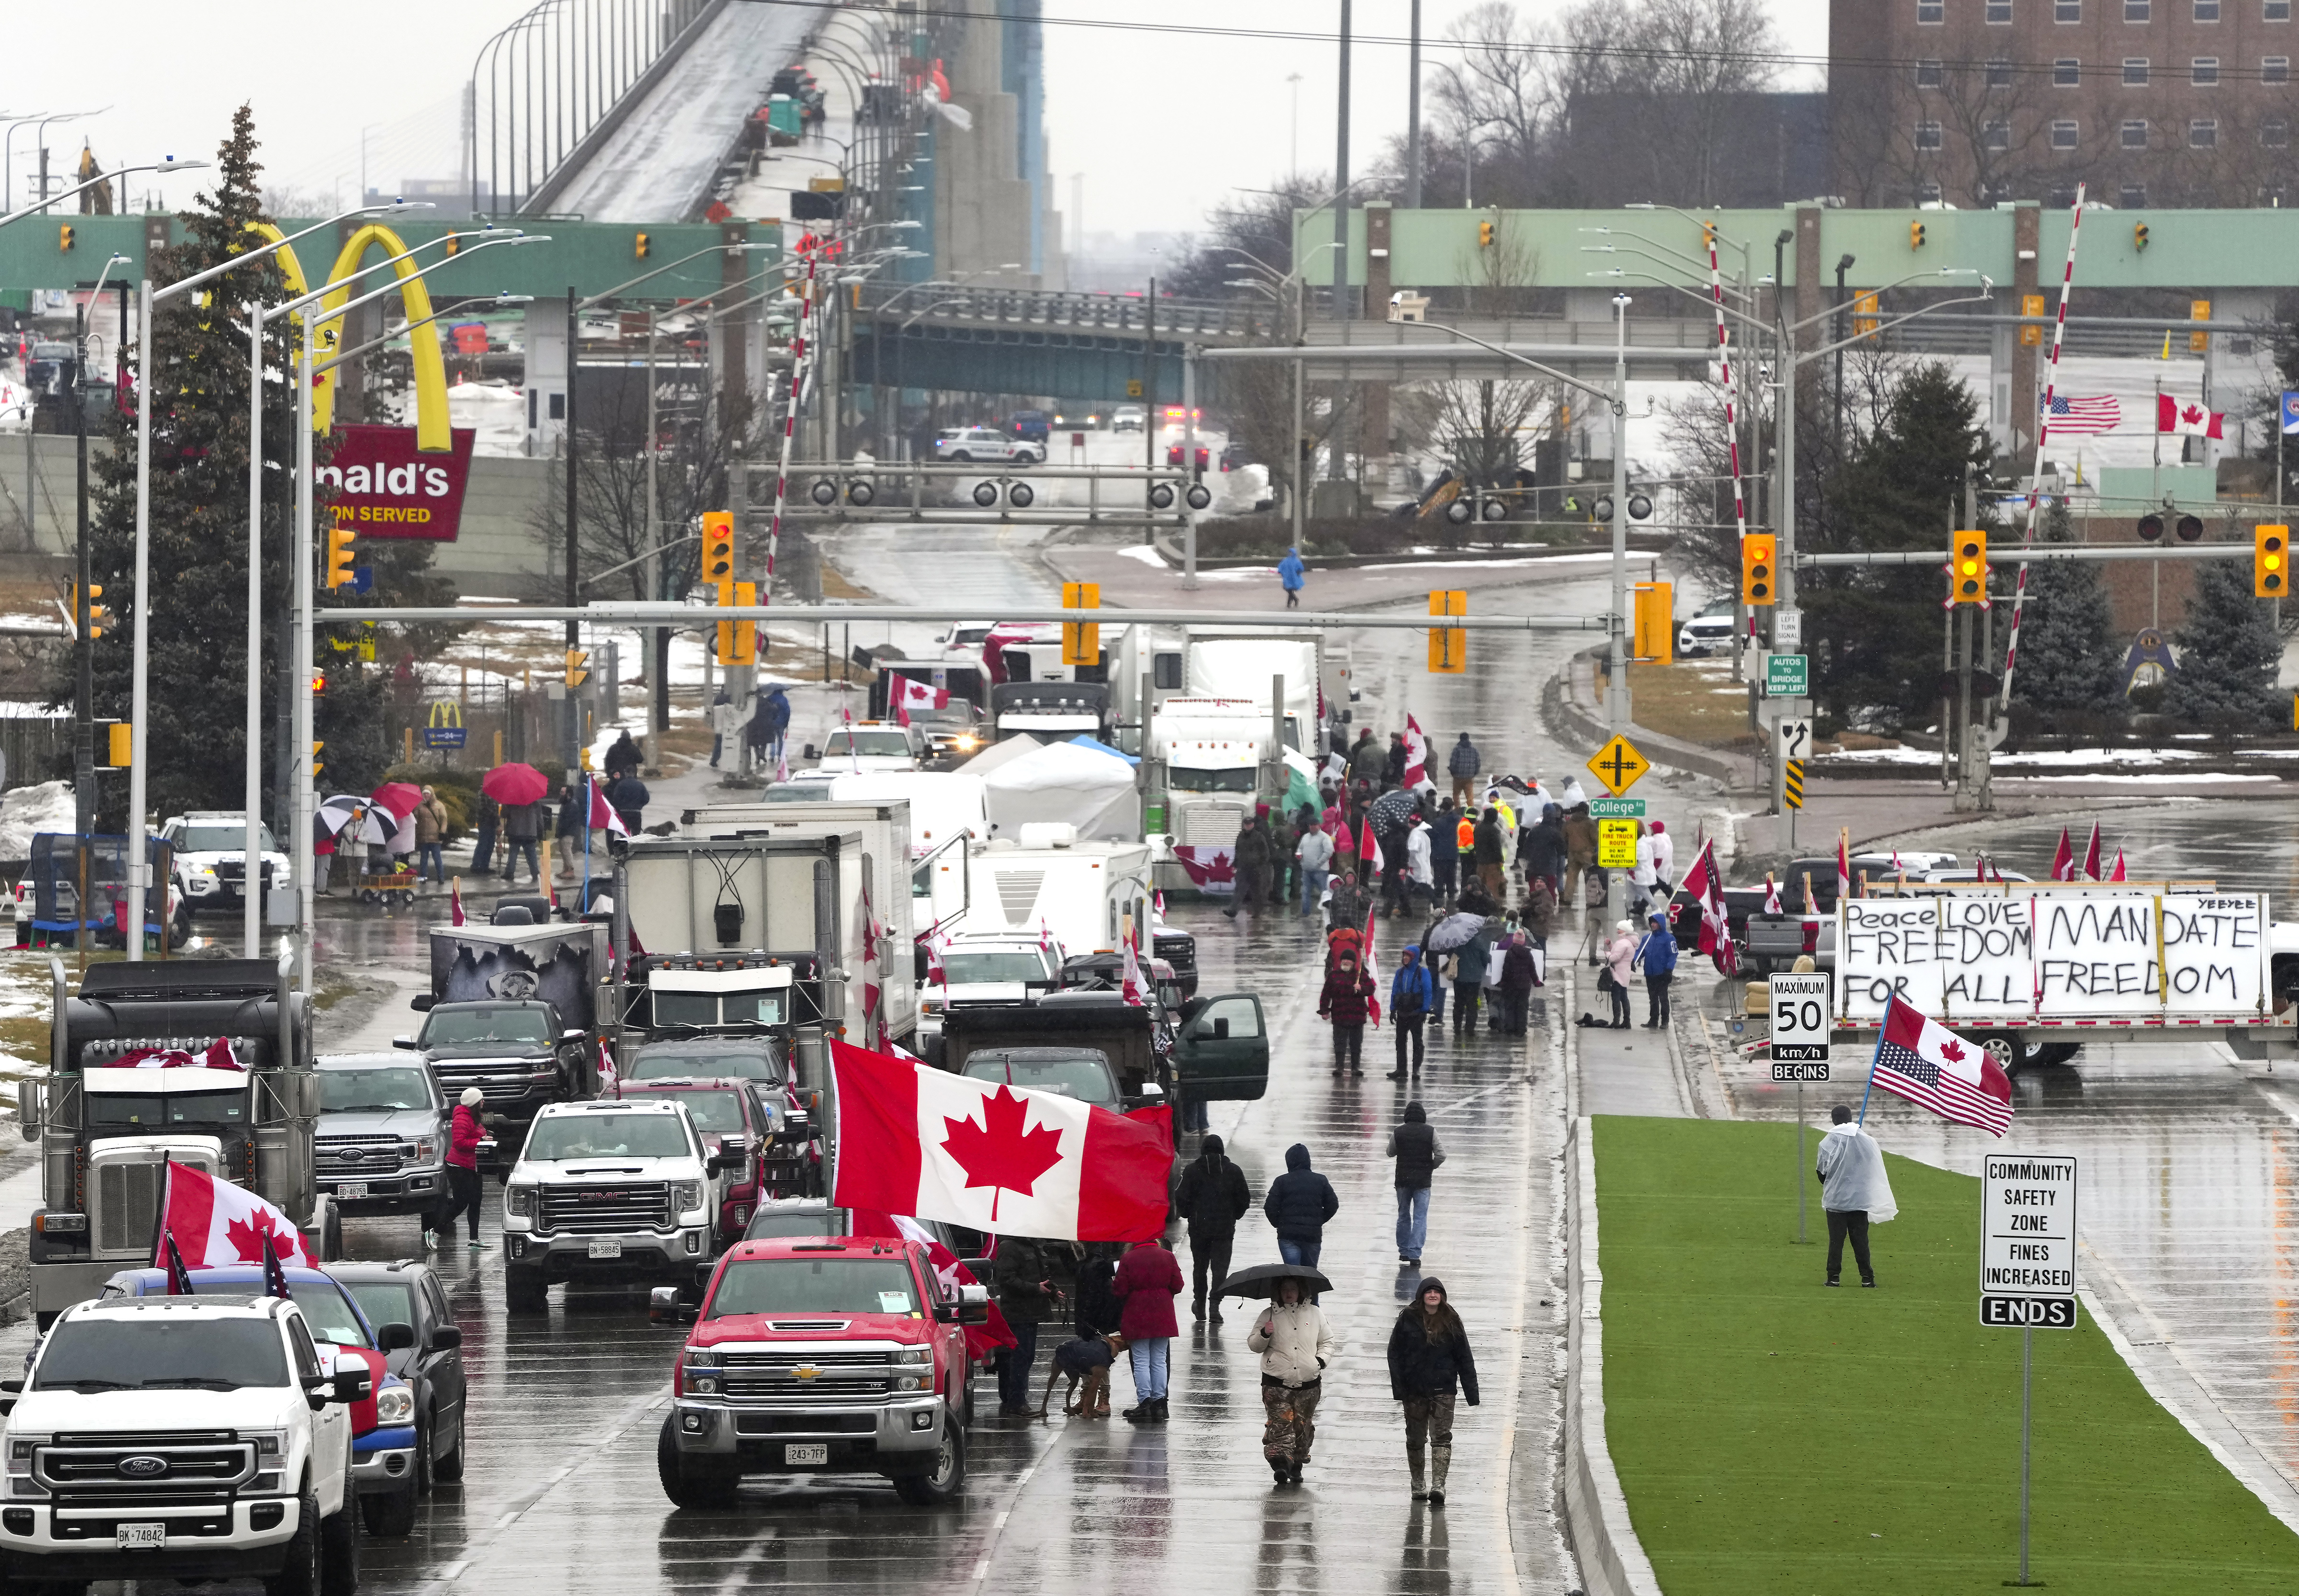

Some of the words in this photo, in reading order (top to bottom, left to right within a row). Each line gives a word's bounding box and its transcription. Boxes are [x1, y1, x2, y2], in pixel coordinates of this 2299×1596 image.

[315, 462, 449, 497] nald's
[360, 506, 431, 523] SERVED
[1592, 801, 1634, 815] College
[1846, 905, 1935, 930] Peace
[1948, 902, 2026, 928] LOVE
[1848, 925, 2032, 965] FREEDOM
[1775, 982, 1824, 994] MAXIMUM
[2041, 960, 2237, 1000] FREEDOM
[1844, 974, 1912, 1005] FOR
[1947, 974, 2028, 1004] ALL
[1777, 1001, 1821, 1032] 50
[1780, 1046, 1820, 1059] km/h
[1774, 1065, 1827, 1079] BEGINS
[1990, 1163, 2071, 1181] COMMUNITY
[580, 1192, 628, 1201] GMC
[2004, 1189, 2056, 1206] SAFETY
[2011, 1215, 2048, 1231] ZONE
[590, 1246, 597, 1254] BN
[601, 1245, 619, 1254] 58845
[2010, 1244, 2049, 1261] FINES
[1987, 1268, 2071, 1286] INCREASED
[1990, 1300, 2066, 1324] ENDS
[792, 1449, 806, 1459] 243
[811, 1449, 825, 1459] 7FP
[130, 1460, 156, 1472] Ford
[119, 1530, 129, 1541] BK
[136, 1529, 162, 1541] 74842
